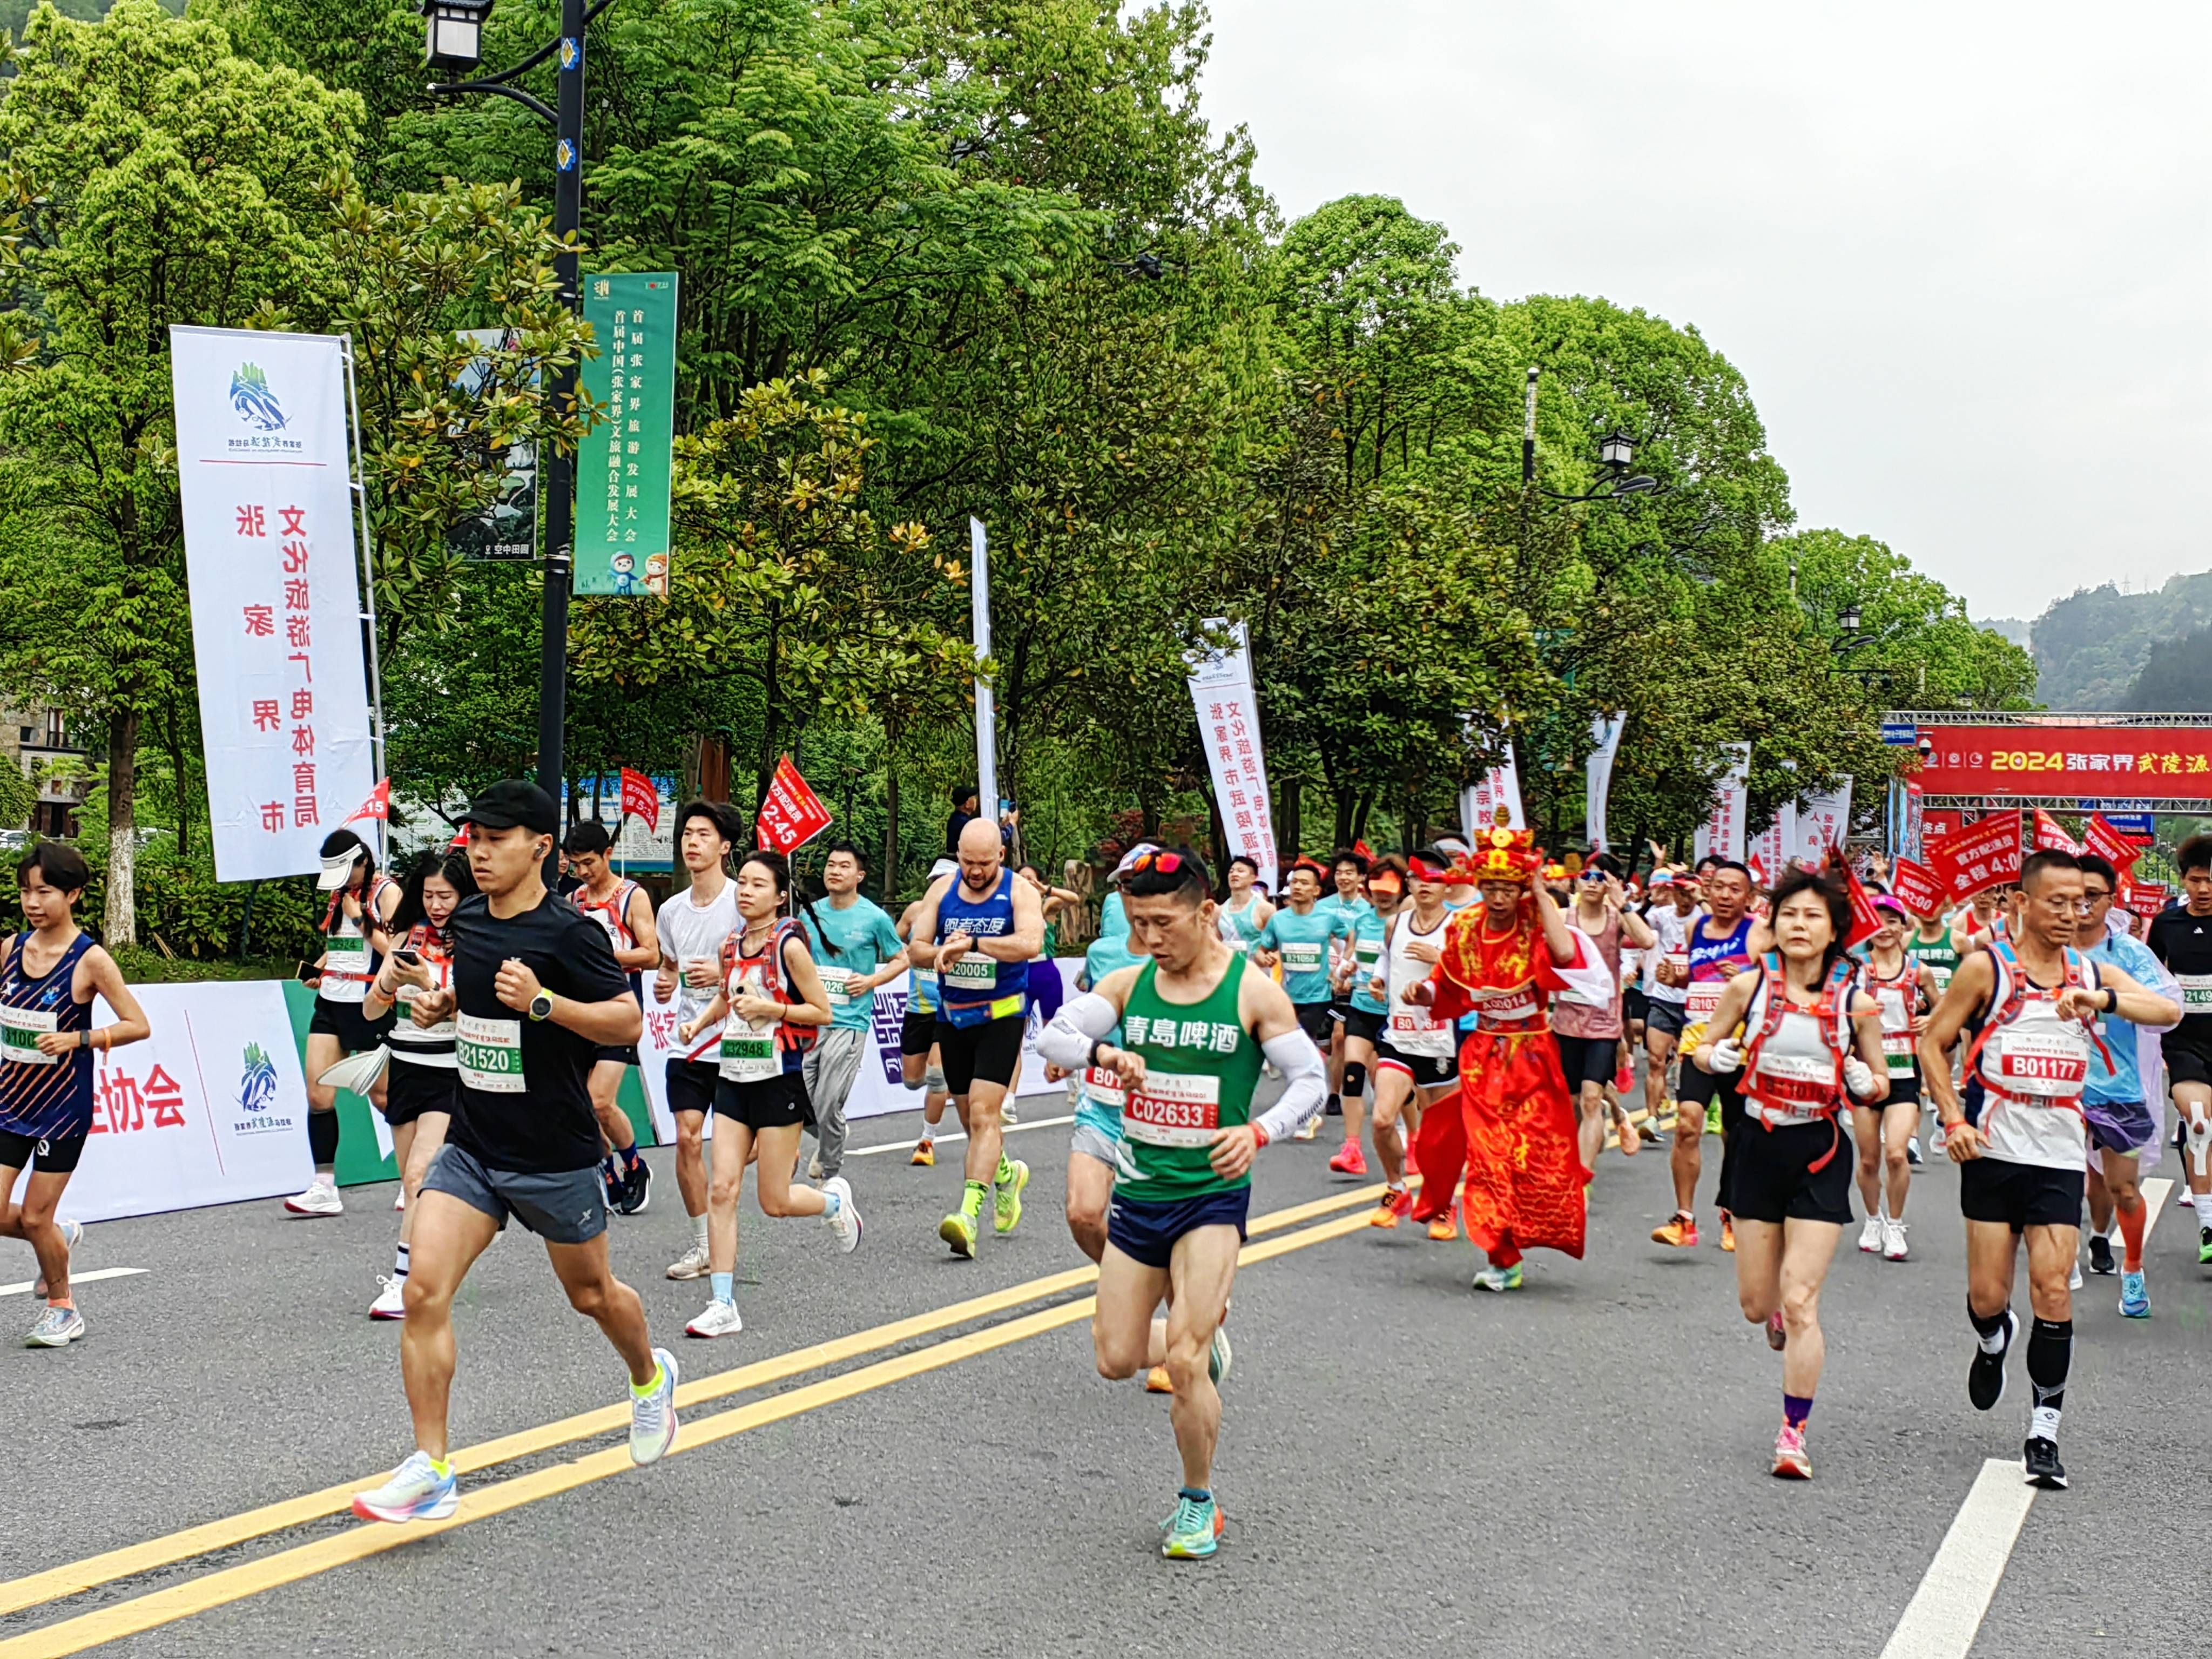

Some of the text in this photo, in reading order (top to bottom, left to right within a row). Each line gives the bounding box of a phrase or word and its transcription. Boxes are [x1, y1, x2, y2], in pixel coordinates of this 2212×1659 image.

[624, 309, 644, 542] 首届张家界旅游发展大会
[762, 805, 798, 845] 2:45
[1955, 834, 2014, 866] 官方配速员
[1954, 864, 1991, 891] 全程
[724, 1042, 764, 1056] C32948
[2012, 1056, 2078, 1079] B01177
[1132, 1097, 1204, 1127] C02633
